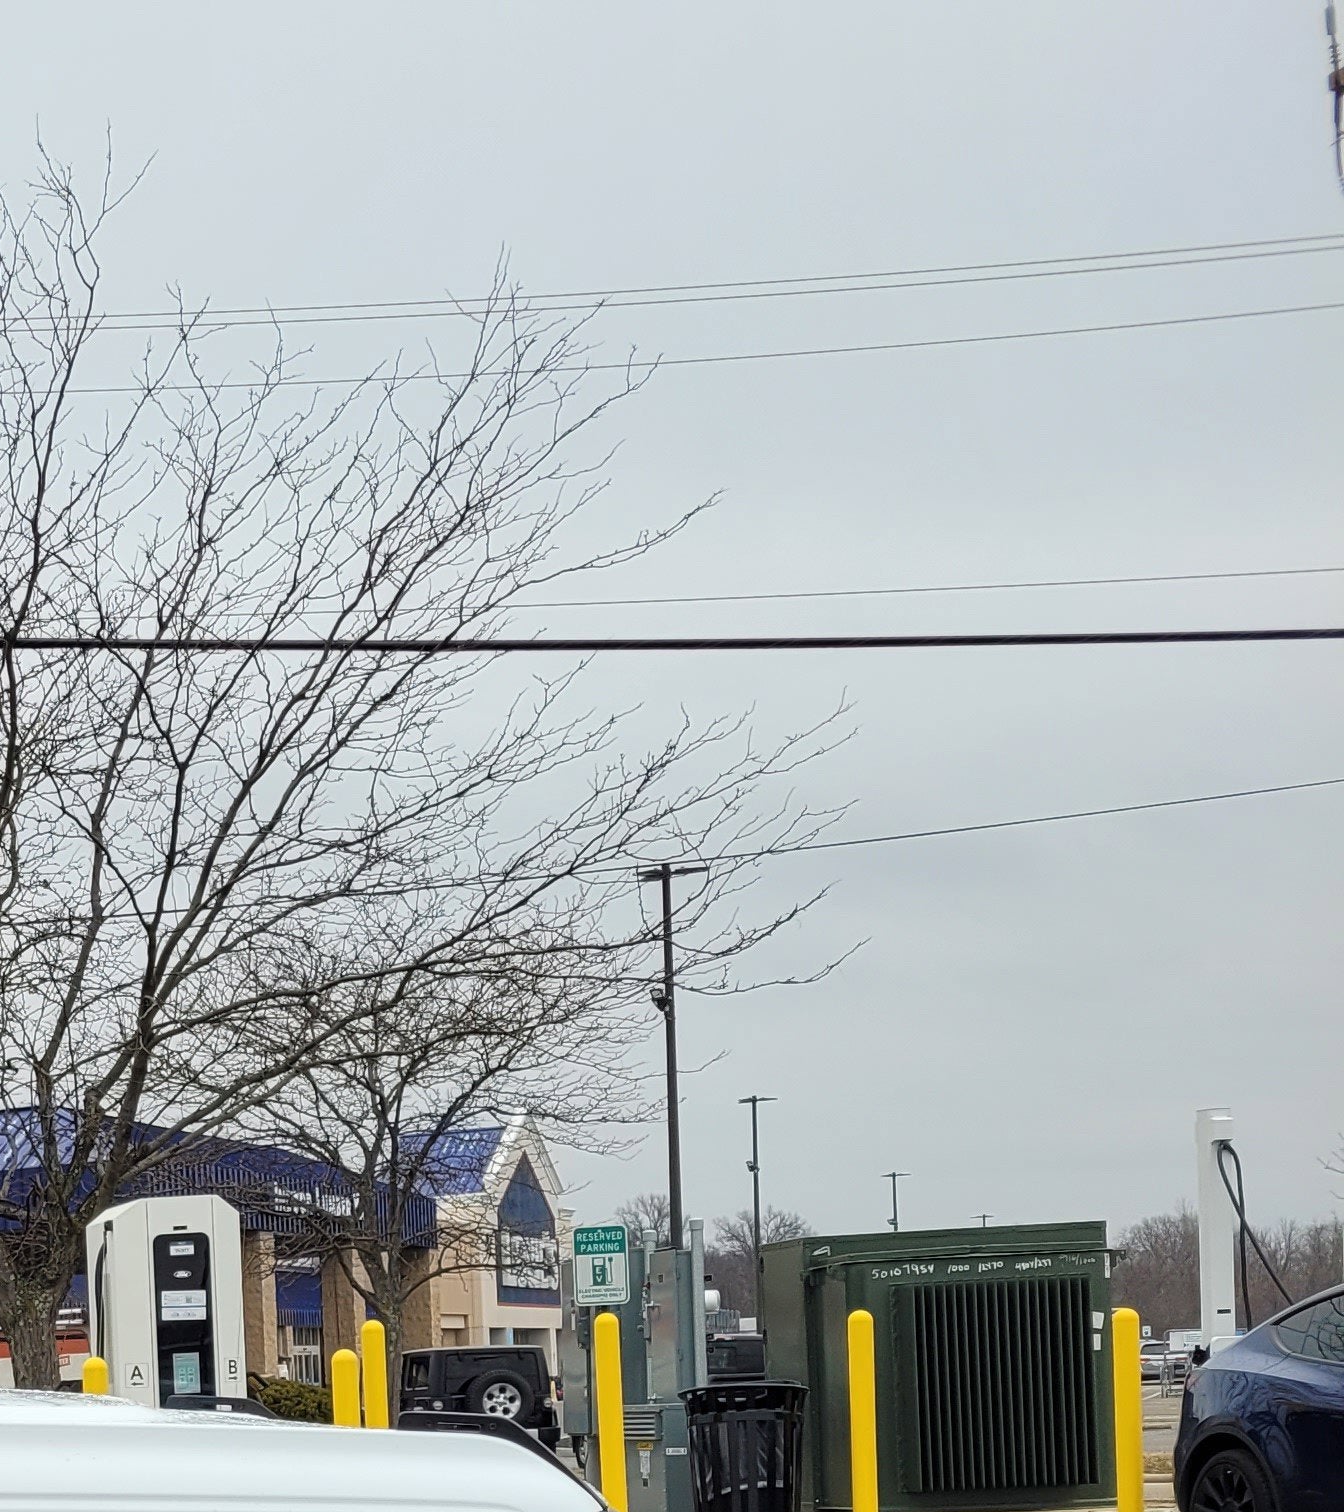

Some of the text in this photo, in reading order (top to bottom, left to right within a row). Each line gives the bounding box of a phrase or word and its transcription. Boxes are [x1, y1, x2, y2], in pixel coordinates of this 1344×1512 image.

[576, 1231, 623, 1242] RESERVED
[580, 1242, 620, 1252] PARKING
[947, 1264, 970, 1274] 1000
[130, 1365, 144, 1381] A
[228, 1360, 238, 1375] B
